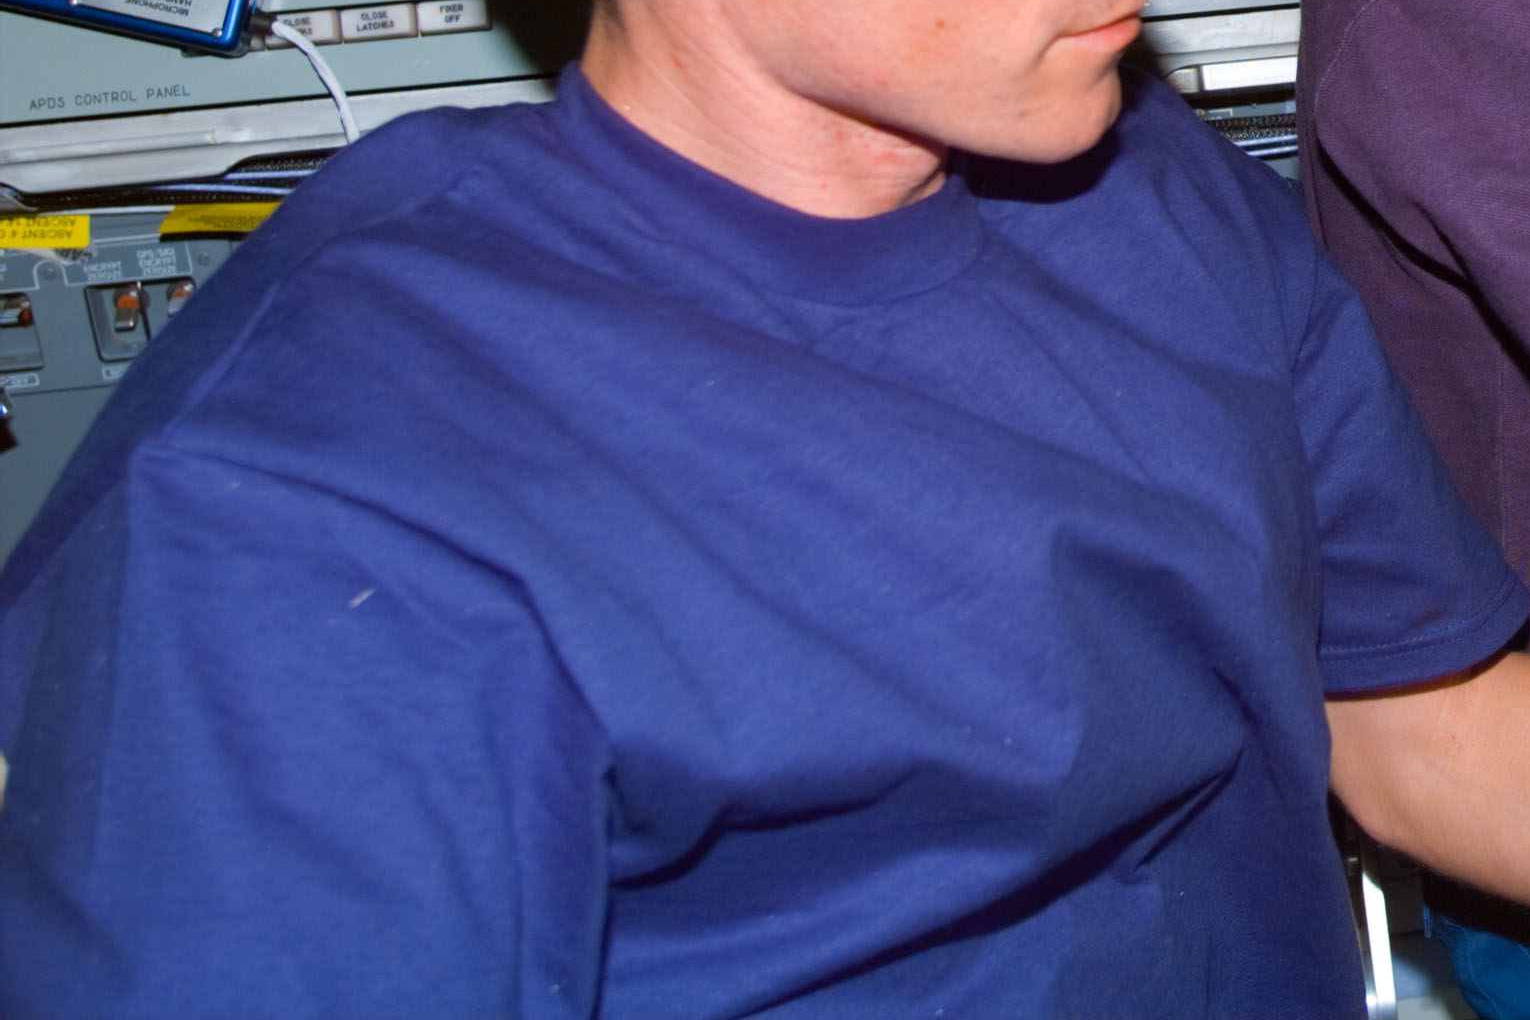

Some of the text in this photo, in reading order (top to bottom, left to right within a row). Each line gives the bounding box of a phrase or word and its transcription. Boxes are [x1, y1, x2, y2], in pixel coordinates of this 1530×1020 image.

[356, 20, 394, 32] LATCHES
[30, 84, 190, 111] APDS CONTROL PANEL
